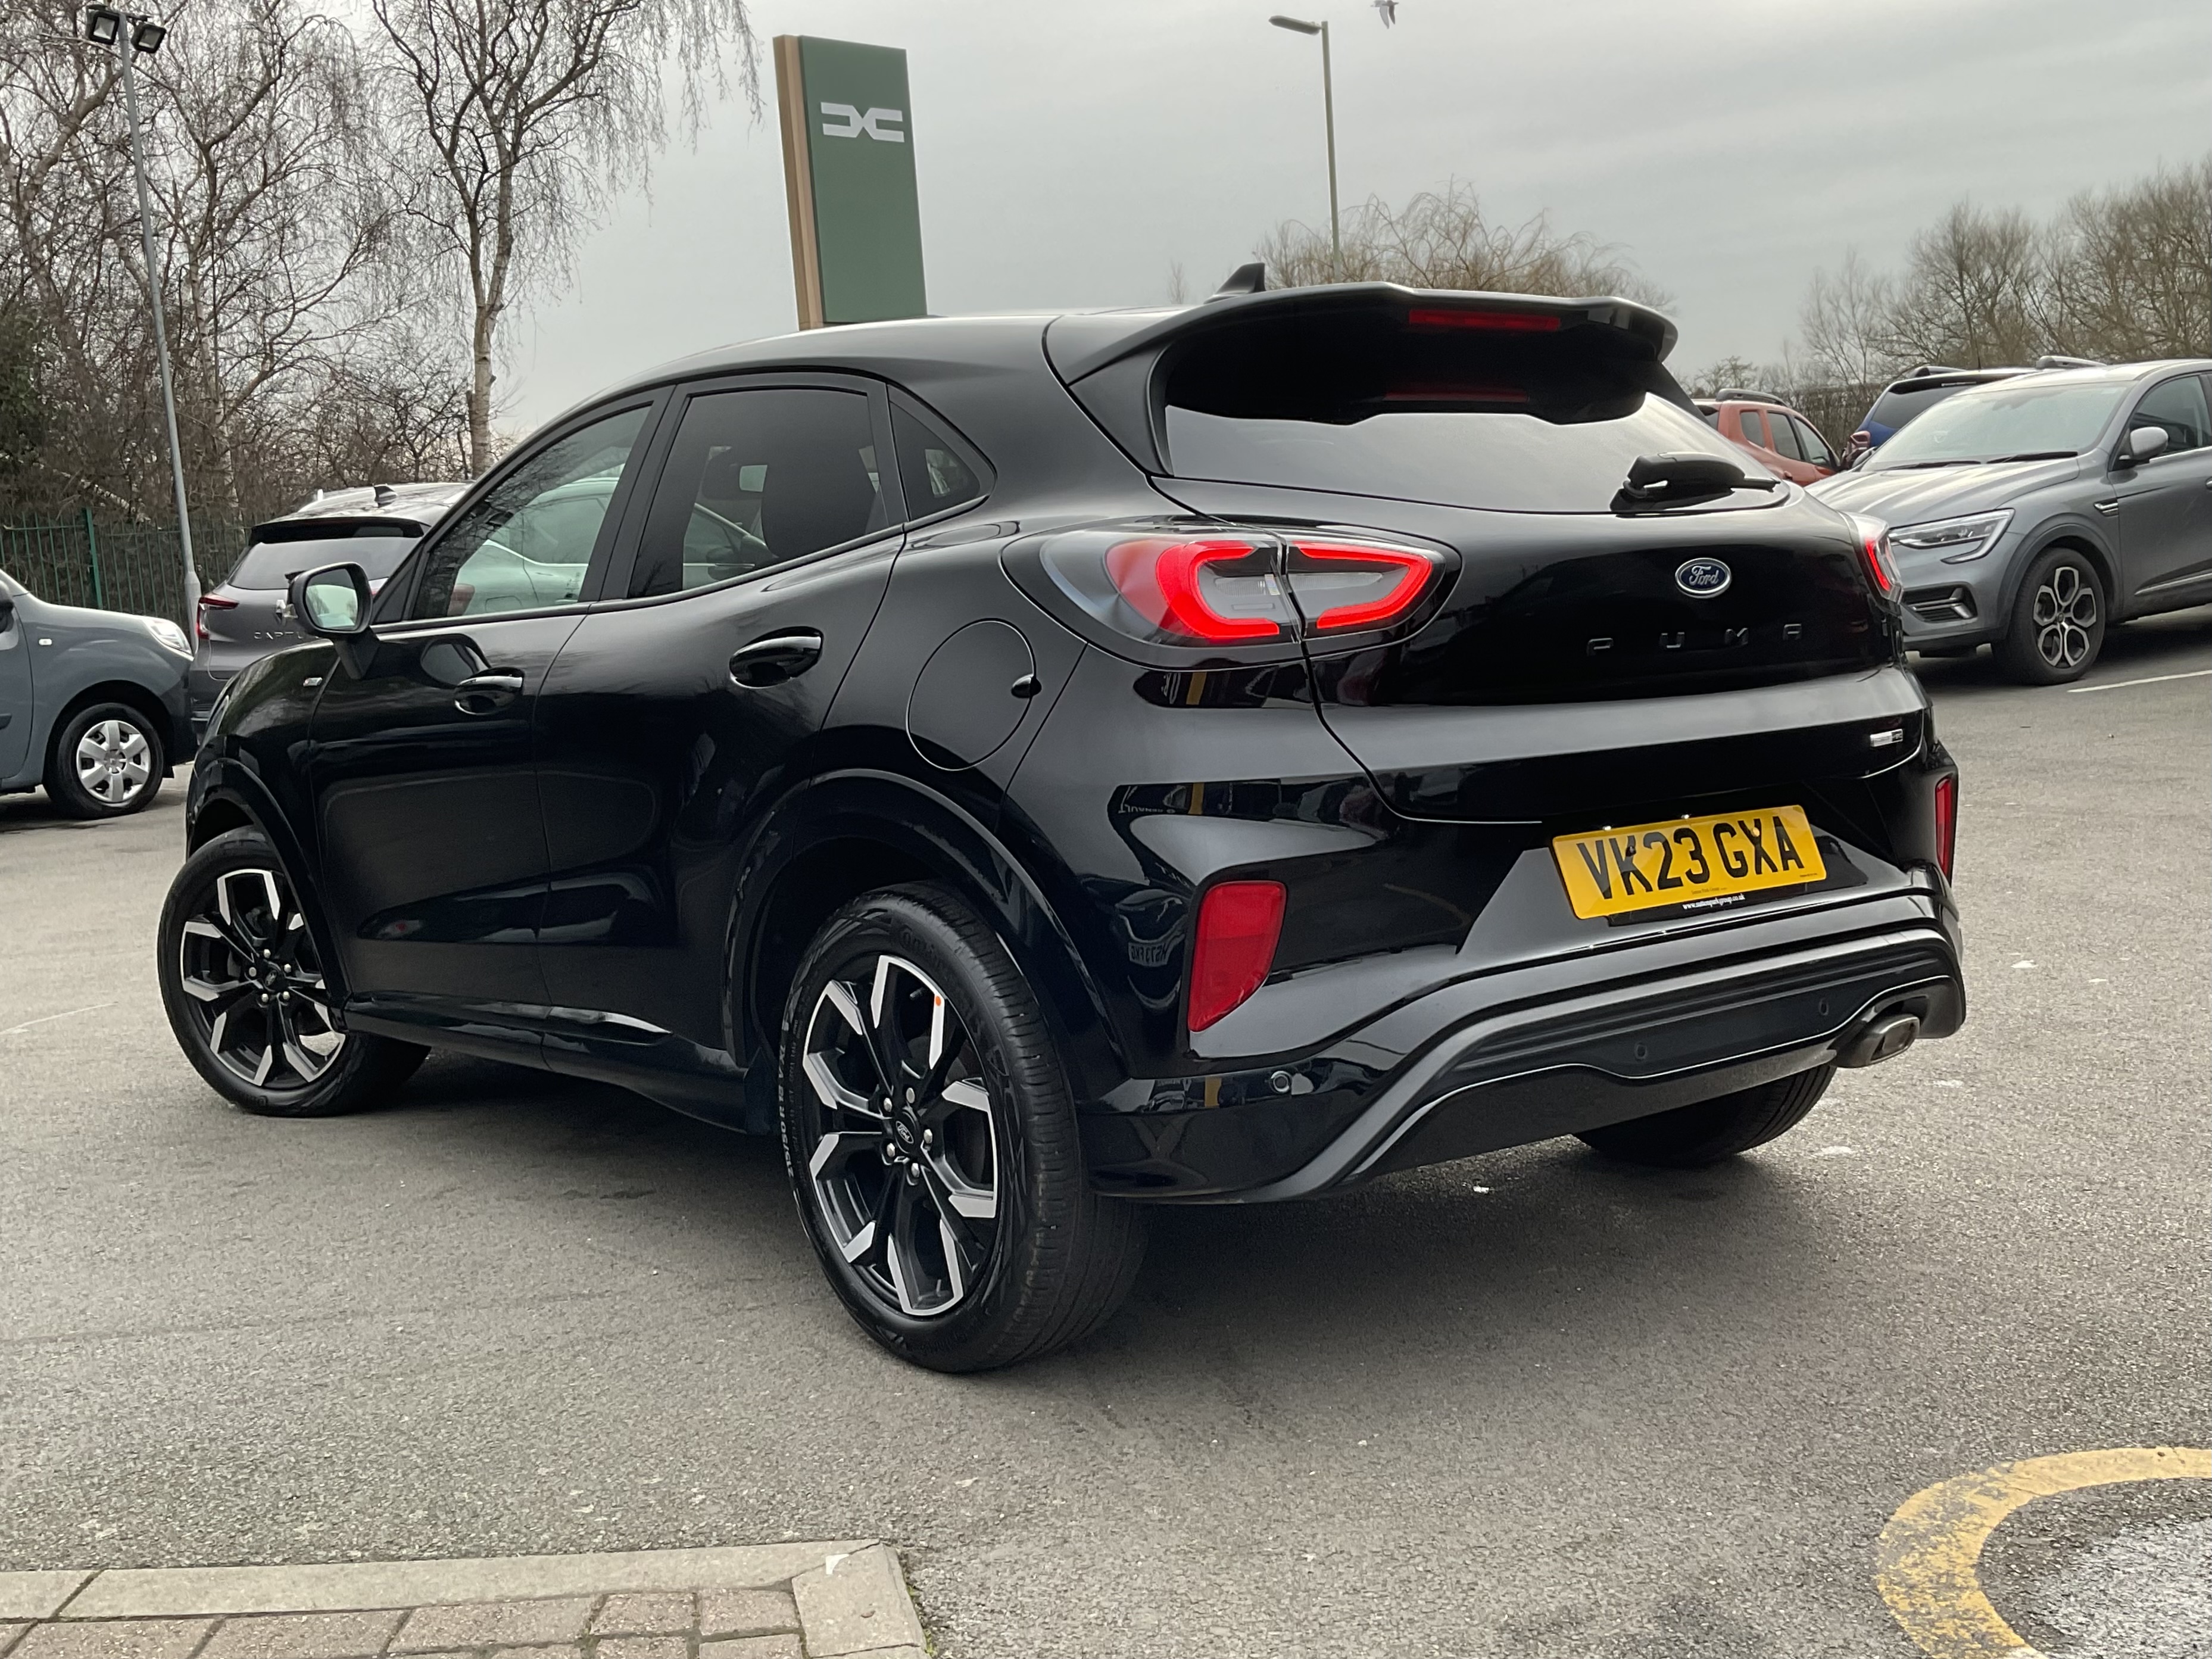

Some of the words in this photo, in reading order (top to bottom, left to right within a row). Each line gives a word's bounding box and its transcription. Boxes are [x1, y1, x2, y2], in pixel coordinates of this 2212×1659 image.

[1689, 565, 1720, 587] Ford
[1586, 622, 1802, 656] PUMA
[1576, 827, 1710, 900] VK23
[1712, 815, 1805, 880] GXA
